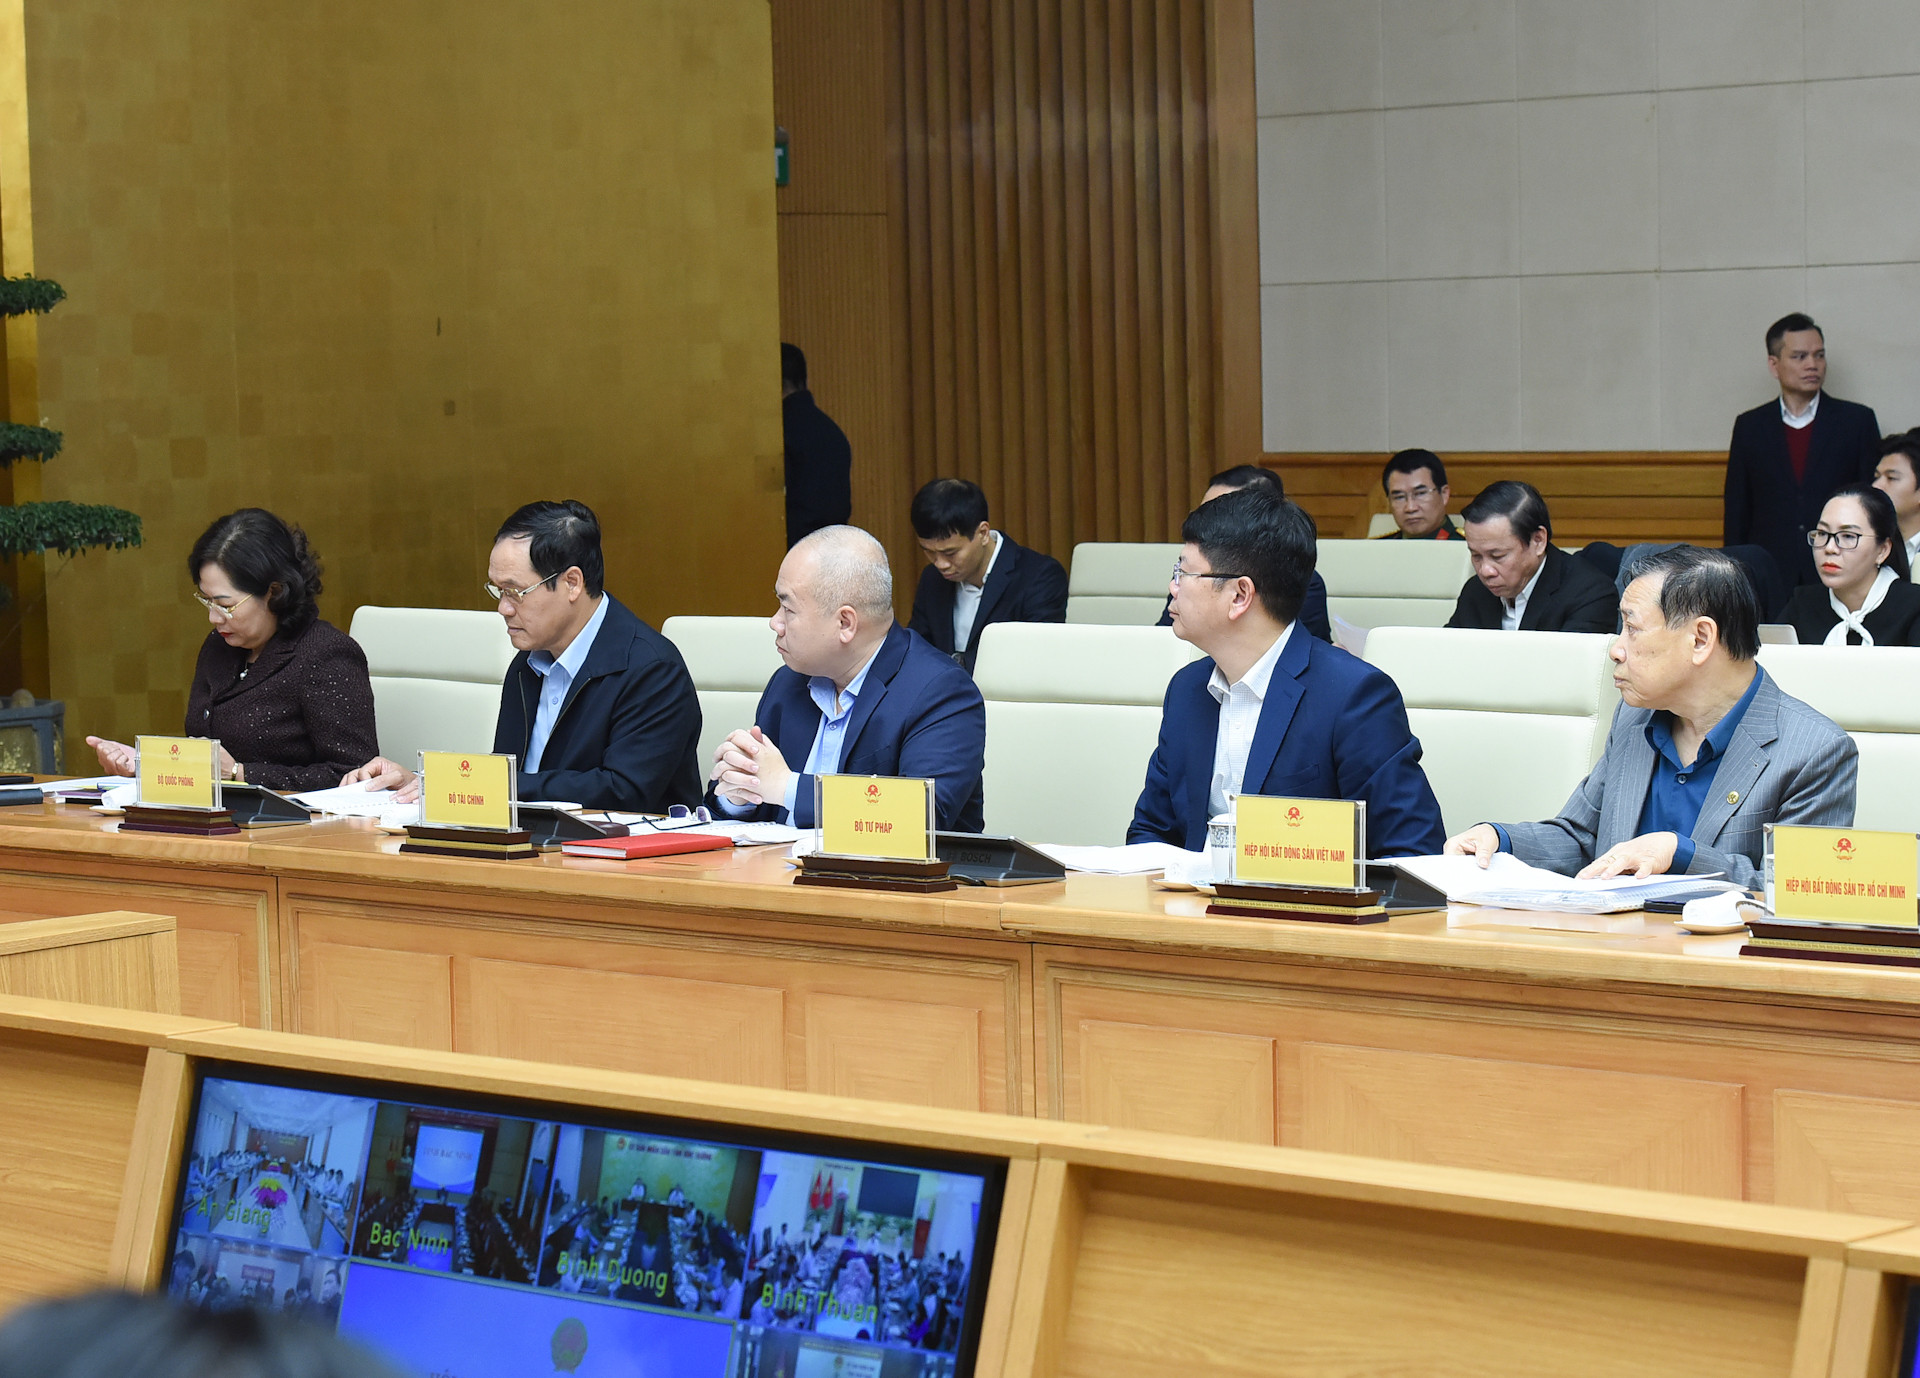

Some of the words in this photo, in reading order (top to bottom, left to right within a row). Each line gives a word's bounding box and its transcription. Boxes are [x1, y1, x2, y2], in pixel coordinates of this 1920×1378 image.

[854, 818, 864, 834] BỘ
[961, 852, 992, 864] BOSCH
[1244, 842, 1258, 859] HIỆP
[1259, 843, 1270, 860] HỘI
[1271, 842, 1283, 858] BẤT
[1302, 845, 1315, 861] SẢN
[1316, 847, 1329, 864] VIỆT
[1330, 850, 1345, 862] NAM
[1785, 876, 1800, 895] HIỆP
[1801, 877, 1812, 896] HỘI
[1843, 878, 1857, 896] SẢN
[1877, 881, 1888, 898] CHÍ
[1889, 885, 1906, 899] MINH
[225, 1199, 271, 1233] Giang
[370, 1221, 402, 1248] Bac
[407, 1228, 448, 1256] Ninh
[606, 1258, 668, 1298] Duong
[816, 1288, 879, 1324] Thuan
